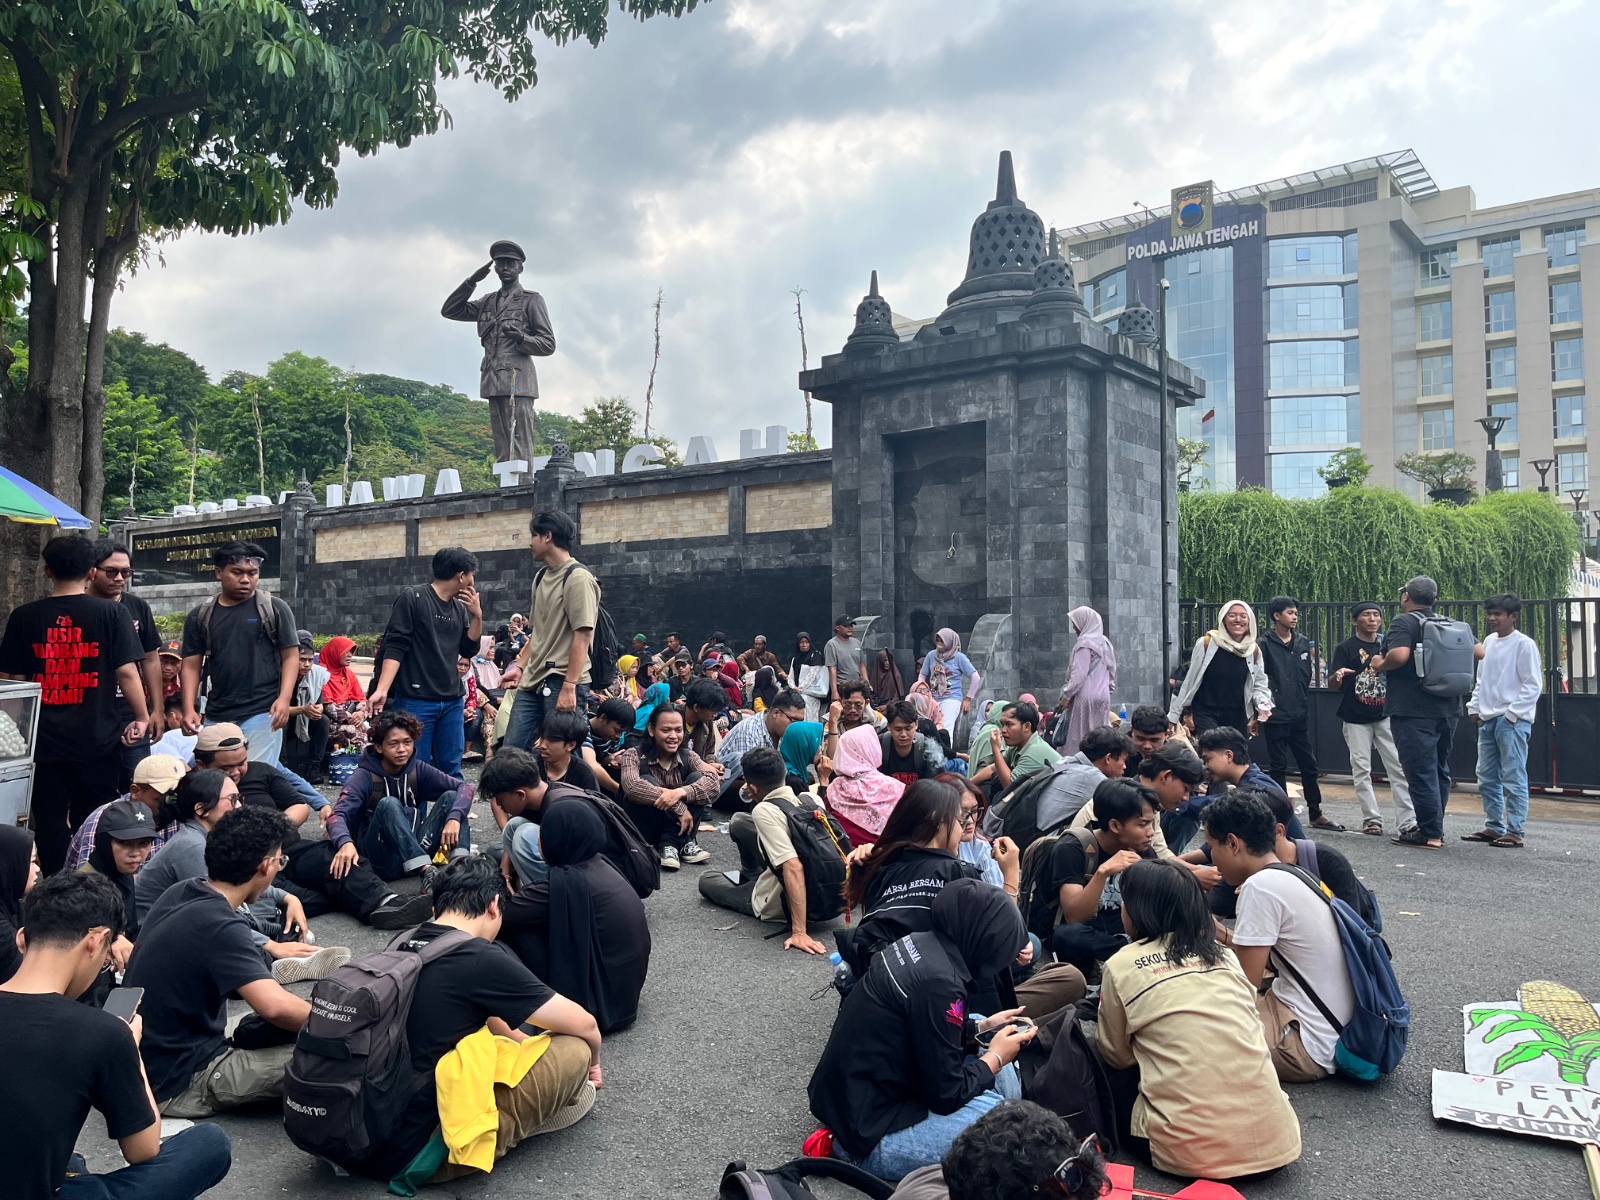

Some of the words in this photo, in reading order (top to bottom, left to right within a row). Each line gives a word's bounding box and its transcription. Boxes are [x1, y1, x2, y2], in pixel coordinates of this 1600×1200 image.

[1127, 239, 1168, 261] POLDA
[1169, 233, 1204, 252] JAWA
[1205, 220, 1259, 244] TENGAH
[47, 627, 82, 643] USIR
[32, 642, 99, 659] TAMBANG
[45, 658, 81, 674] DARI
[909, 879, 946, 889] BERSAM
[1135, 952, 1168, 969] SEKOL
